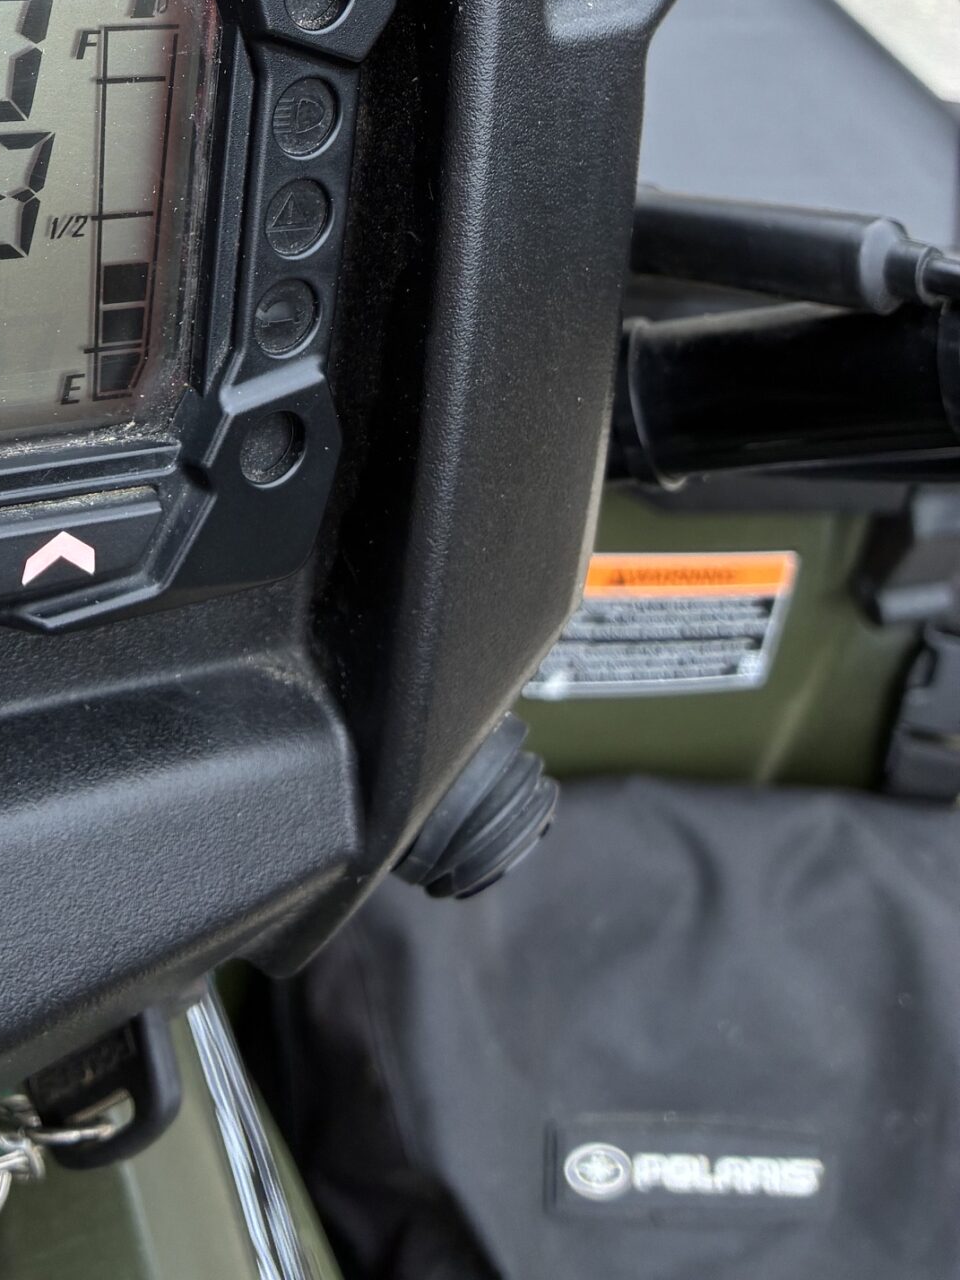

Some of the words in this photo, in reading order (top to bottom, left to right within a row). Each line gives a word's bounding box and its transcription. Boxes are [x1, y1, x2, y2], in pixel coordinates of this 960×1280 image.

[76, 29, 102, 60] F
[49, 215, 89, 240] 1/2
[62, 373, 86, 404] E
